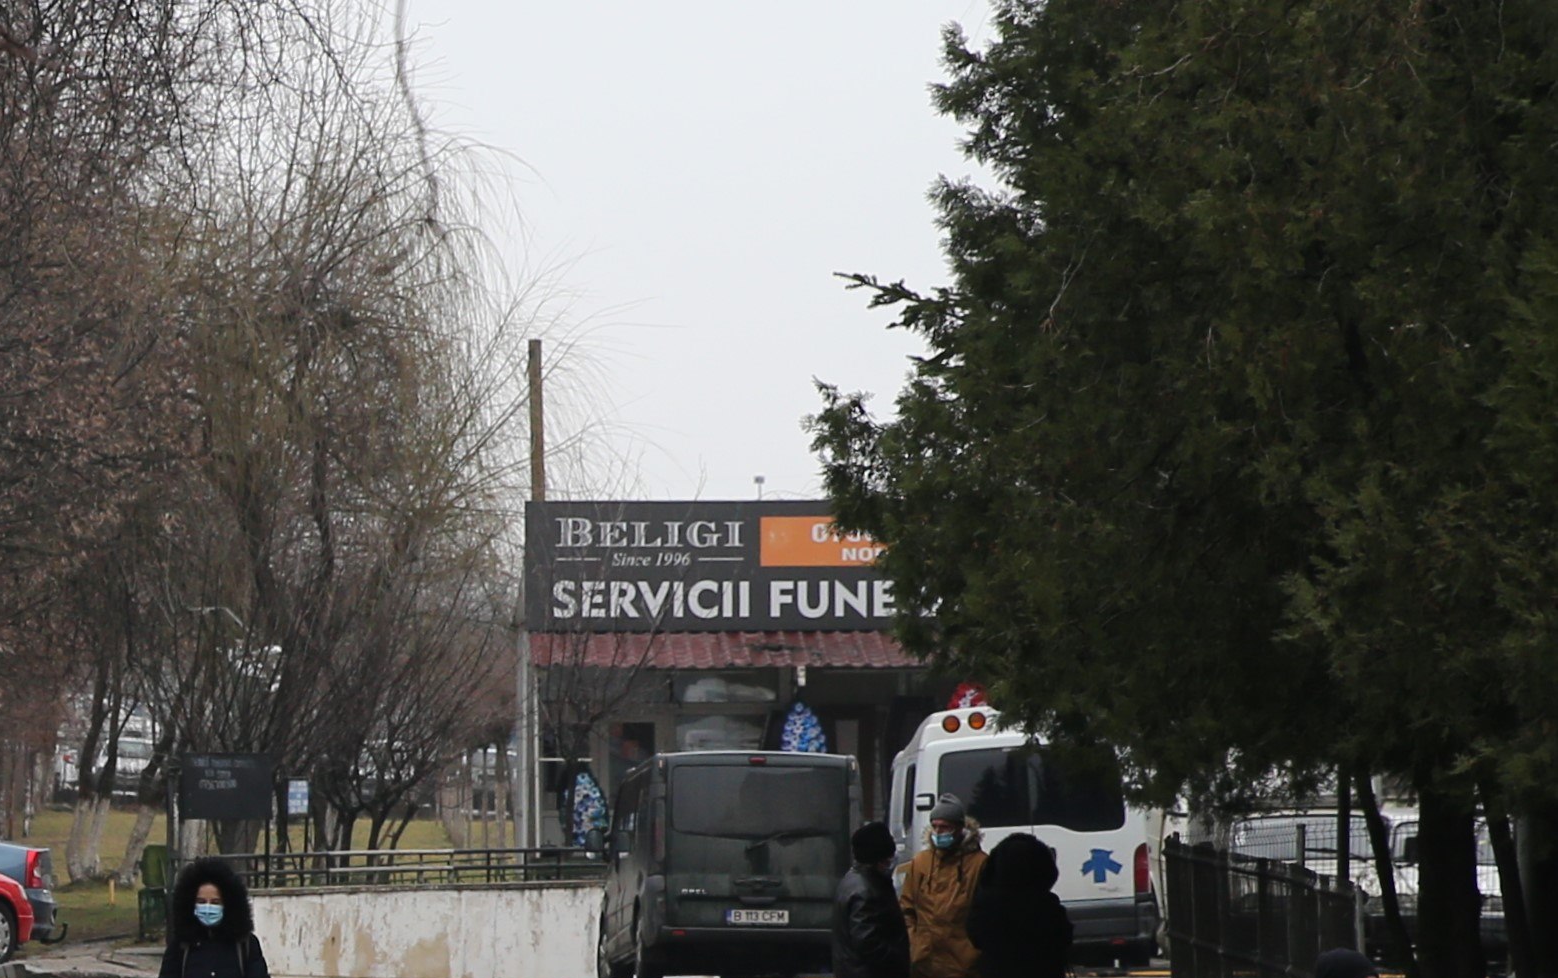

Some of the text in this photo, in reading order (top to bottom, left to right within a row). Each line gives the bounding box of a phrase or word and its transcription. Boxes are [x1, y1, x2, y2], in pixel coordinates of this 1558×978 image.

[555, 517, 745, 548] BELIGI
[612, 552, 691, 567] Since 1996
[552, 580, 897, 619] SERVICII FUNE
[734, 911, 785, 921] B 113 CFM
